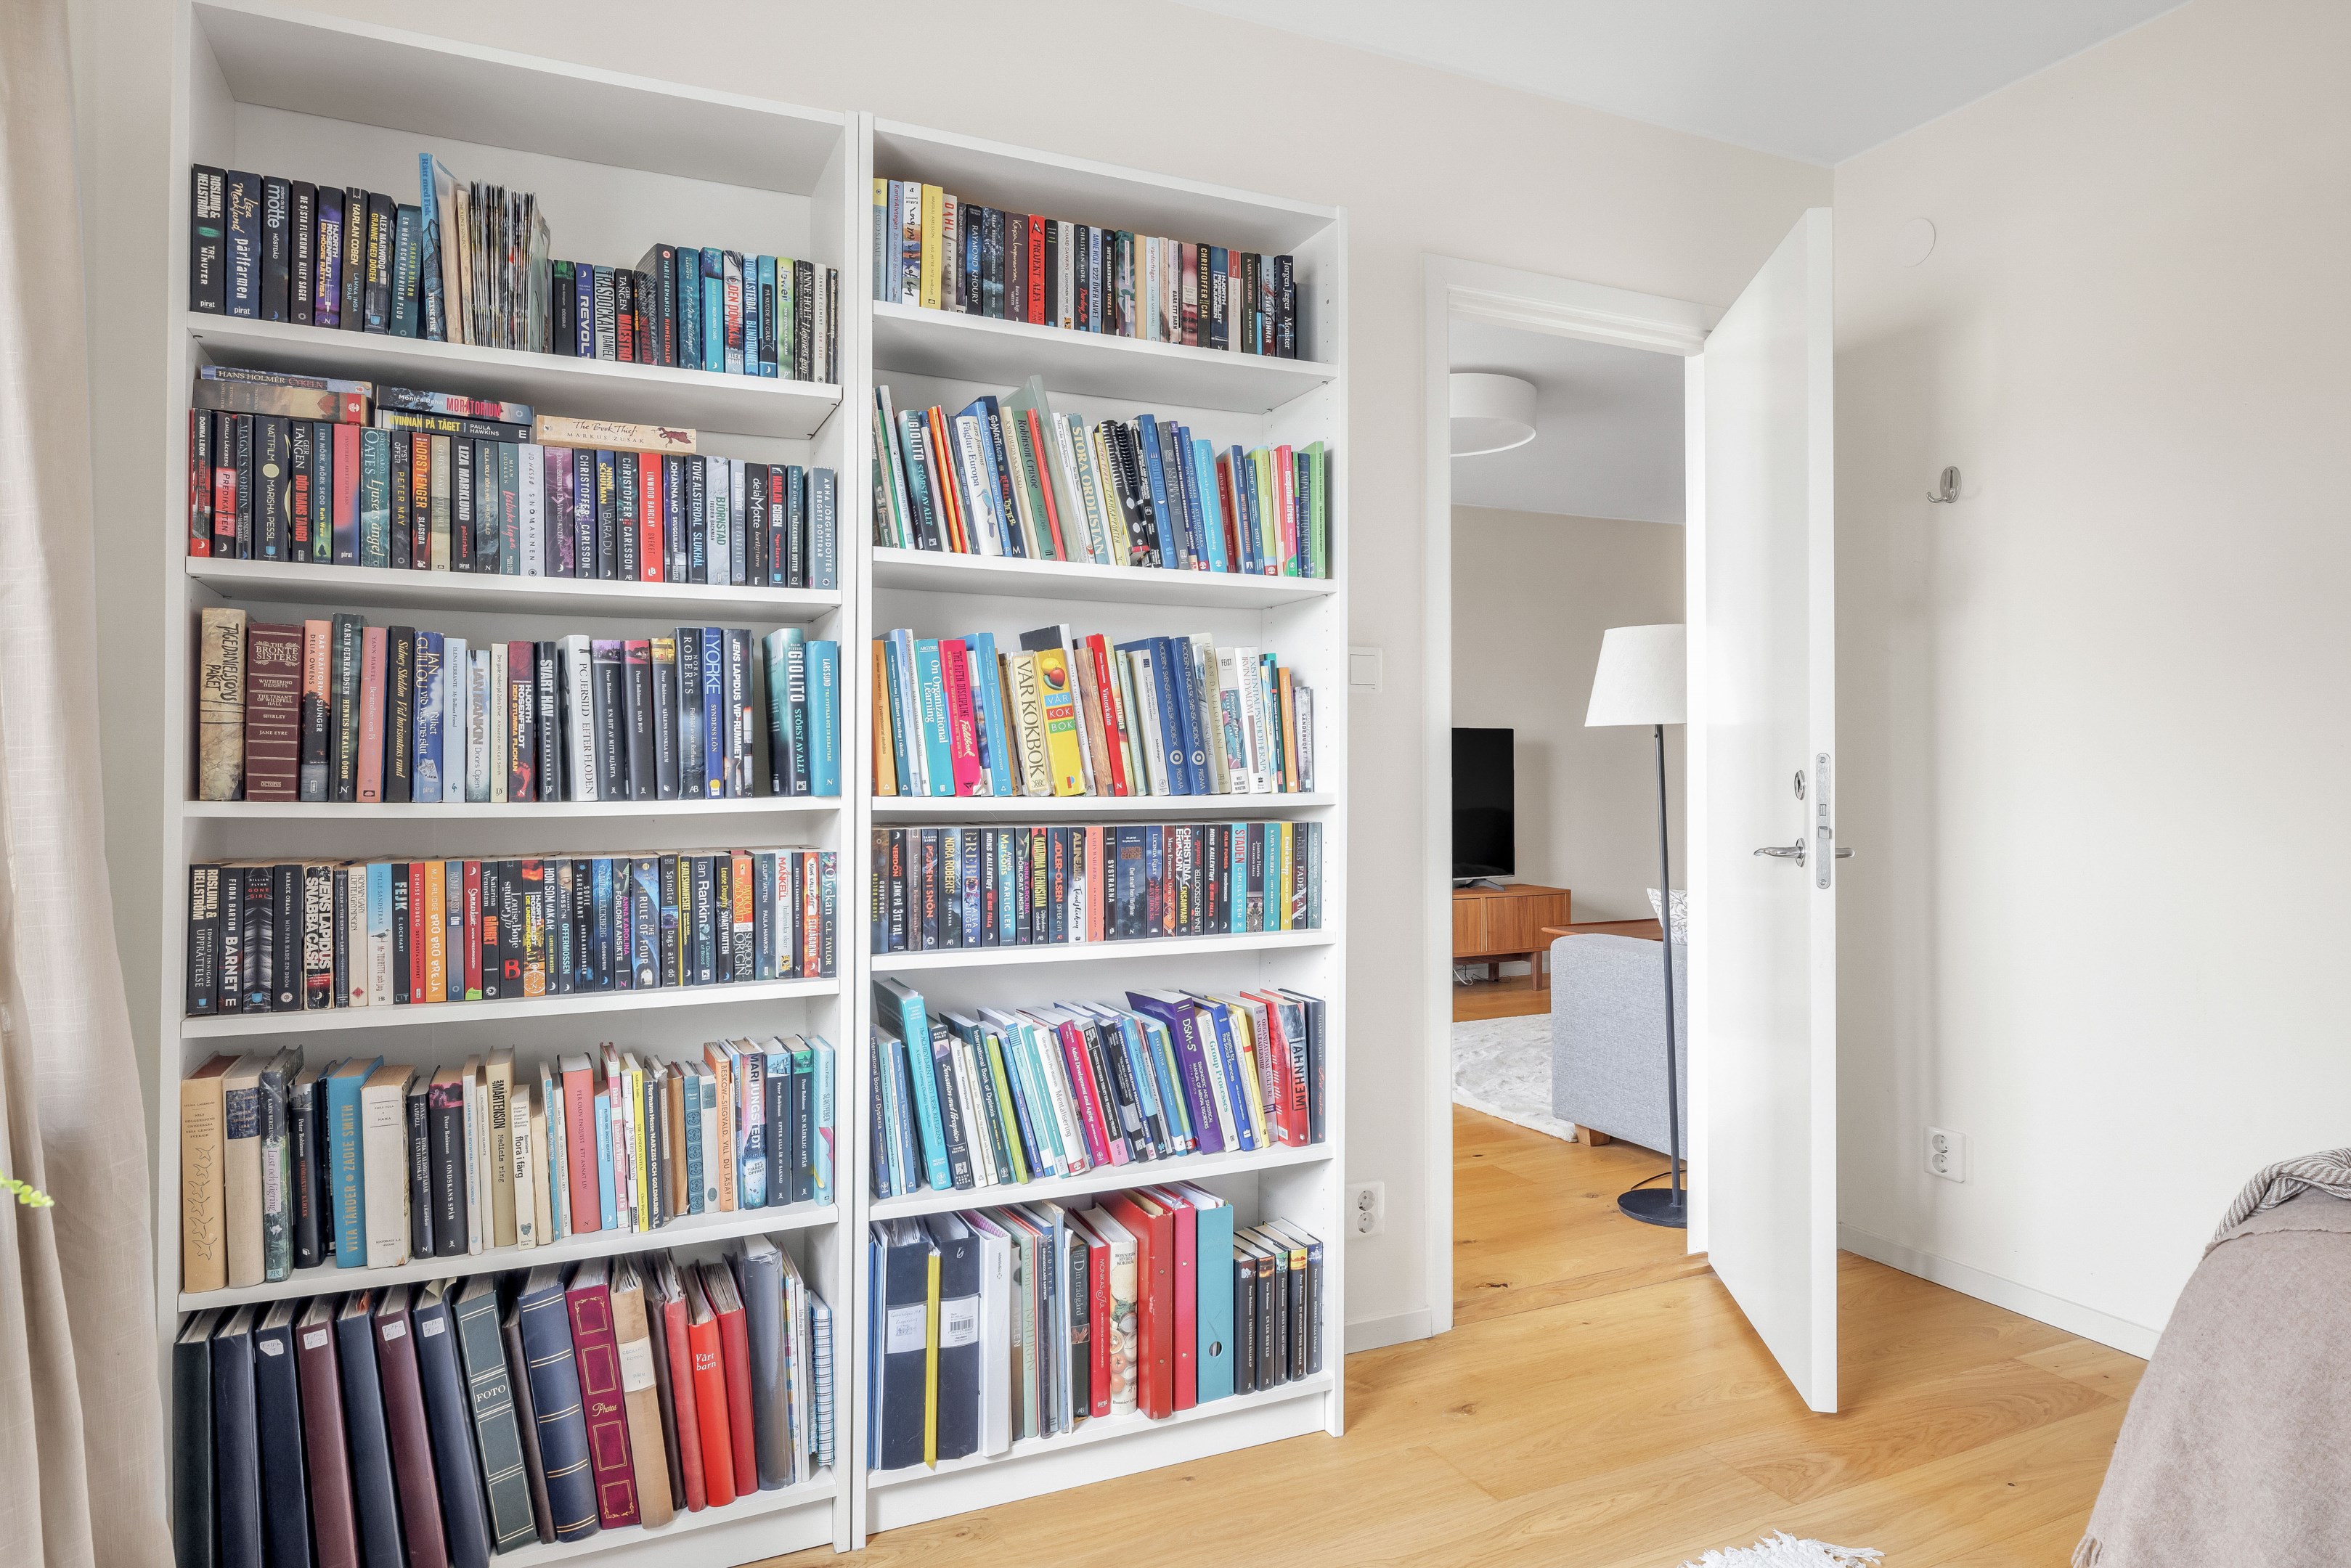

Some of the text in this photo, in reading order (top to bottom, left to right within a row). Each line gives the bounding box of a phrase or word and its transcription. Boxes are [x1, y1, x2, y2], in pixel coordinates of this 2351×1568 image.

[197, 173, 209, 218] HELLSTRÖM
[210, 175, 221, 208] ROSLUND
[232, 183, 245, 234] Marklund
[243, 197, 258, 218] Liza
[267, 184, 280, 229] motte
[351, 204, 360, 237] HARLAN
[235, 238, 248, 299] pärlfarmen
[378, 232, 386, 270] MARWOOD
[619, 314, 632, 361] MAESTRO
[219, 369, 285, 384] HANS HOLMÉR
[425, 417, 435, 428] PÅ
[437, 419, 460, 432] TÅGET
[446, 397, 502, 417] MORATORIUM
[294, 427, 303, 469] TANGEN
[567, 433, 607, 441] MARKUS
[573, 422, 637, 435] The Book Thief
[415, 441, 428, 507] HORST ENGER
[1017, 419, 1038, 489] Robinson Crusoe
[458, 446, 469, 521] LIZA MARKLUND
[1072, 426, 1105, 555] STORA ORDLISTAN
[296, 474, 308, 542] DÖD MANS TANGO
[716, 497, 725, 546] BJÖRNSTAD
[624, 527, 632, 570] CARLSSON
[256, 651, 298, 661] SISTERS
[416, 637, 428, 689] GUILLOU
[428, 652, 441, 675] JAN
[706, 639, 720, 695] YORKE
[732, 638, 741, 663] JENS
[540, 659, 553, 716] SVART HAV
[733, 663, 741, 701] LAPIDUS
[789, 652, 804, 702] GIOLITO
[924, 682, 935, 723] Learning
[930, 659, 948, 743] On Organizational
[1017, 660, 1045, 779] VÅR KOKBOK
[1048, 694, 1069, 704] VÅR
[1048, 707, 1072, 717] KOK
[1102, 687, 1112, 726] Vinterkalas
[1050, 720, 1075, 731] BOK
[945, 836, 955, 894] NORA ROBERTS
[1235, 829, 1244, 864] STADEN
[698, 881, 709, 925] Rankin
[825, 867, 836, 915] Olyckan
[306, 877, 319, 969] SNABBA CASH
[319, 877, 330, 969] JENS LAPIDUS
[640, 923, 648, 933] OF
[225, 936, 237, 992] BARNET
[750, 1081, 759, 1149] JUNGSTEDT
[1056, 1090, 1072, 1137] Mentalisering
[341, 1104, 357, 1252] VITA TÄNDER ZADIE SMITH
[1074, 1259, 1085, 1280] Din
[1075, 1281, 1085, 1316] trädgård
[696, 1353, 714, 1363] Vårt
[696, 1360, 716, 1371] barn
[476, 1384, 506, 1402] FOTO
[592, 1402, 617, 1417] Photos
